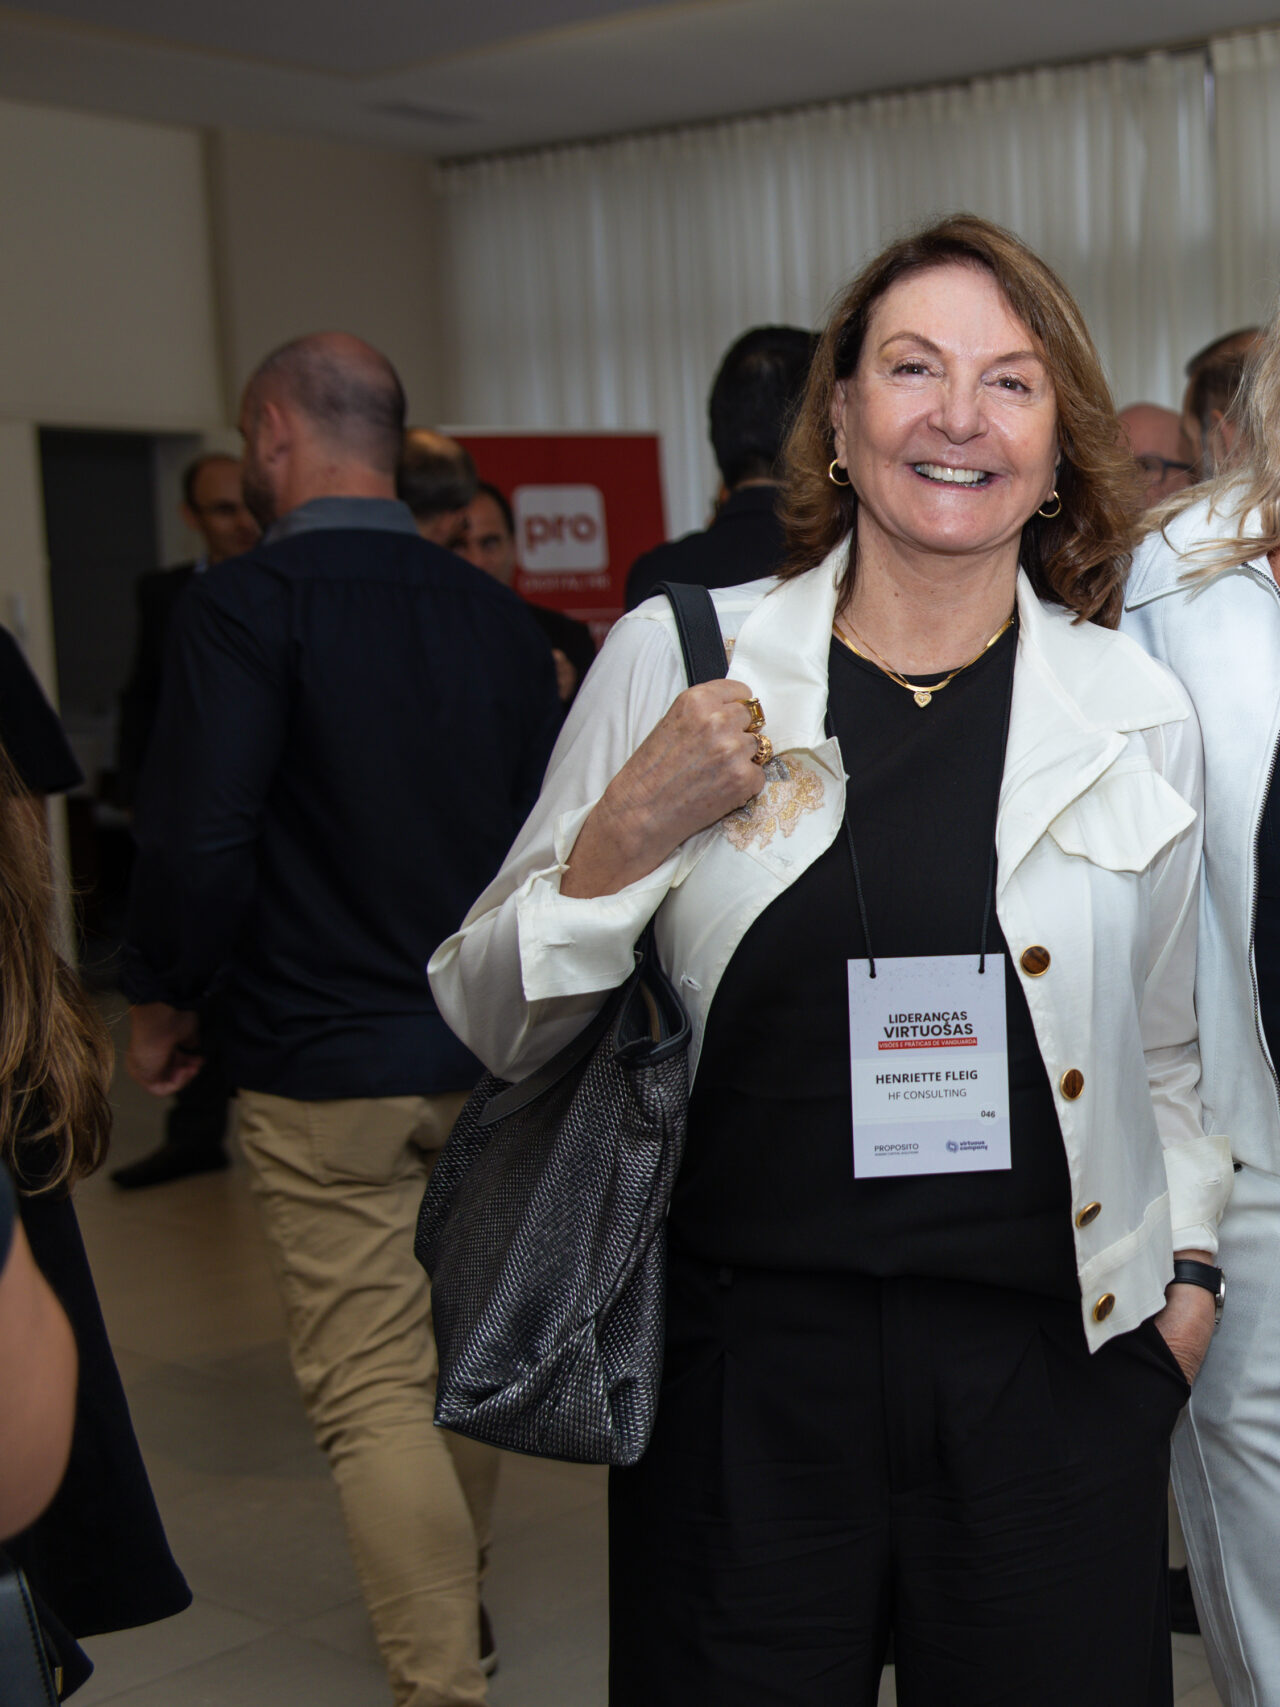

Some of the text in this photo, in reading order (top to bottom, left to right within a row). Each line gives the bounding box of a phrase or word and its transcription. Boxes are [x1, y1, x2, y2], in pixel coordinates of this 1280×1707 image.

[525, 513, 597, 554] pro
[888, 1011, 968, 1025] LIDERANÇAS
[884, 1023, 973, 1038] VIRTUOSAS
[879, 1041, 899, 1049] VISÕES
[904, 1039, 932, 1048] PRÁTICAS
[876, 1069, 978, 1084] HENRIETTE FLEIG
[888, 1088, 967, 1100] HF CONSULTING
[980, 1110, 996, 1118] 046
[874, 1143, 919, 1152] PROPOSITO
